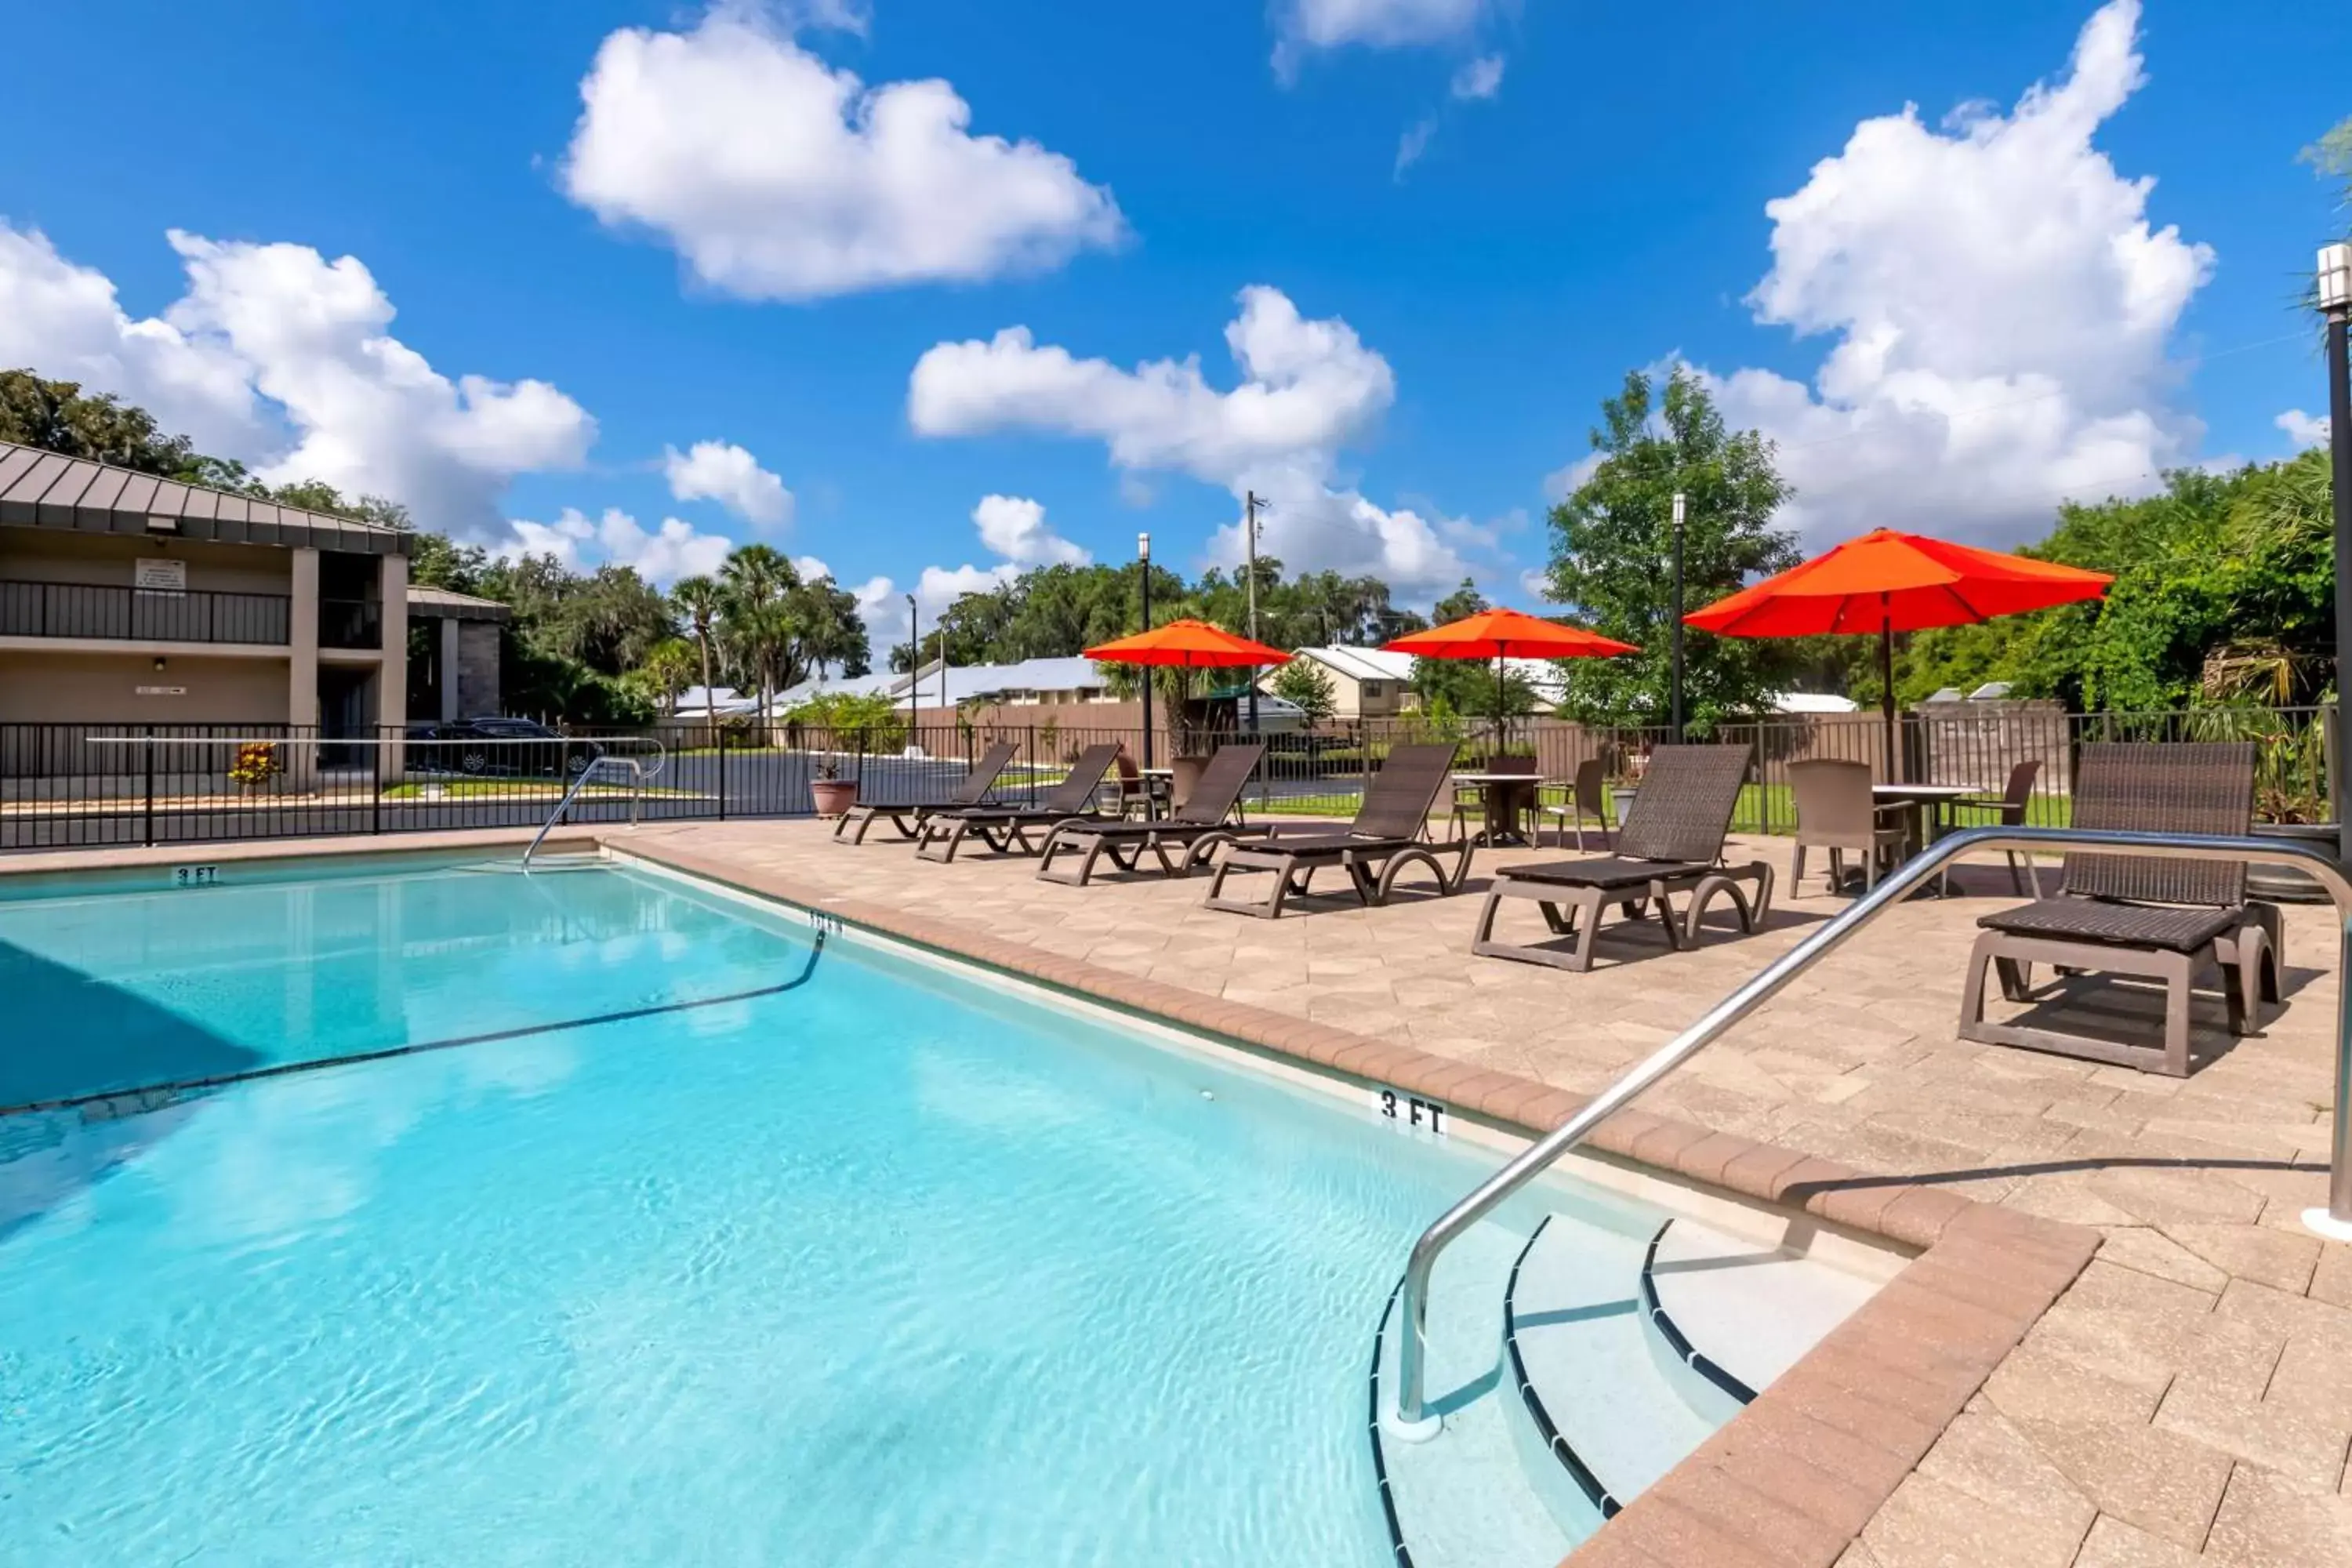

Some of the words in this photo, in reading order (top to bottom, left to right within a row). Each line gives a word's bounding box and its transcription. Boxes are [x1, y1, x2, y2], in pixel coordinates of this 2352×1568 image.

[178, 868, 188, 880] 3
[196, 866, 216, 880] FT
[1381, 1090, 1396, 1119] 3
[1410, 1098, 1443, 1133] FT
